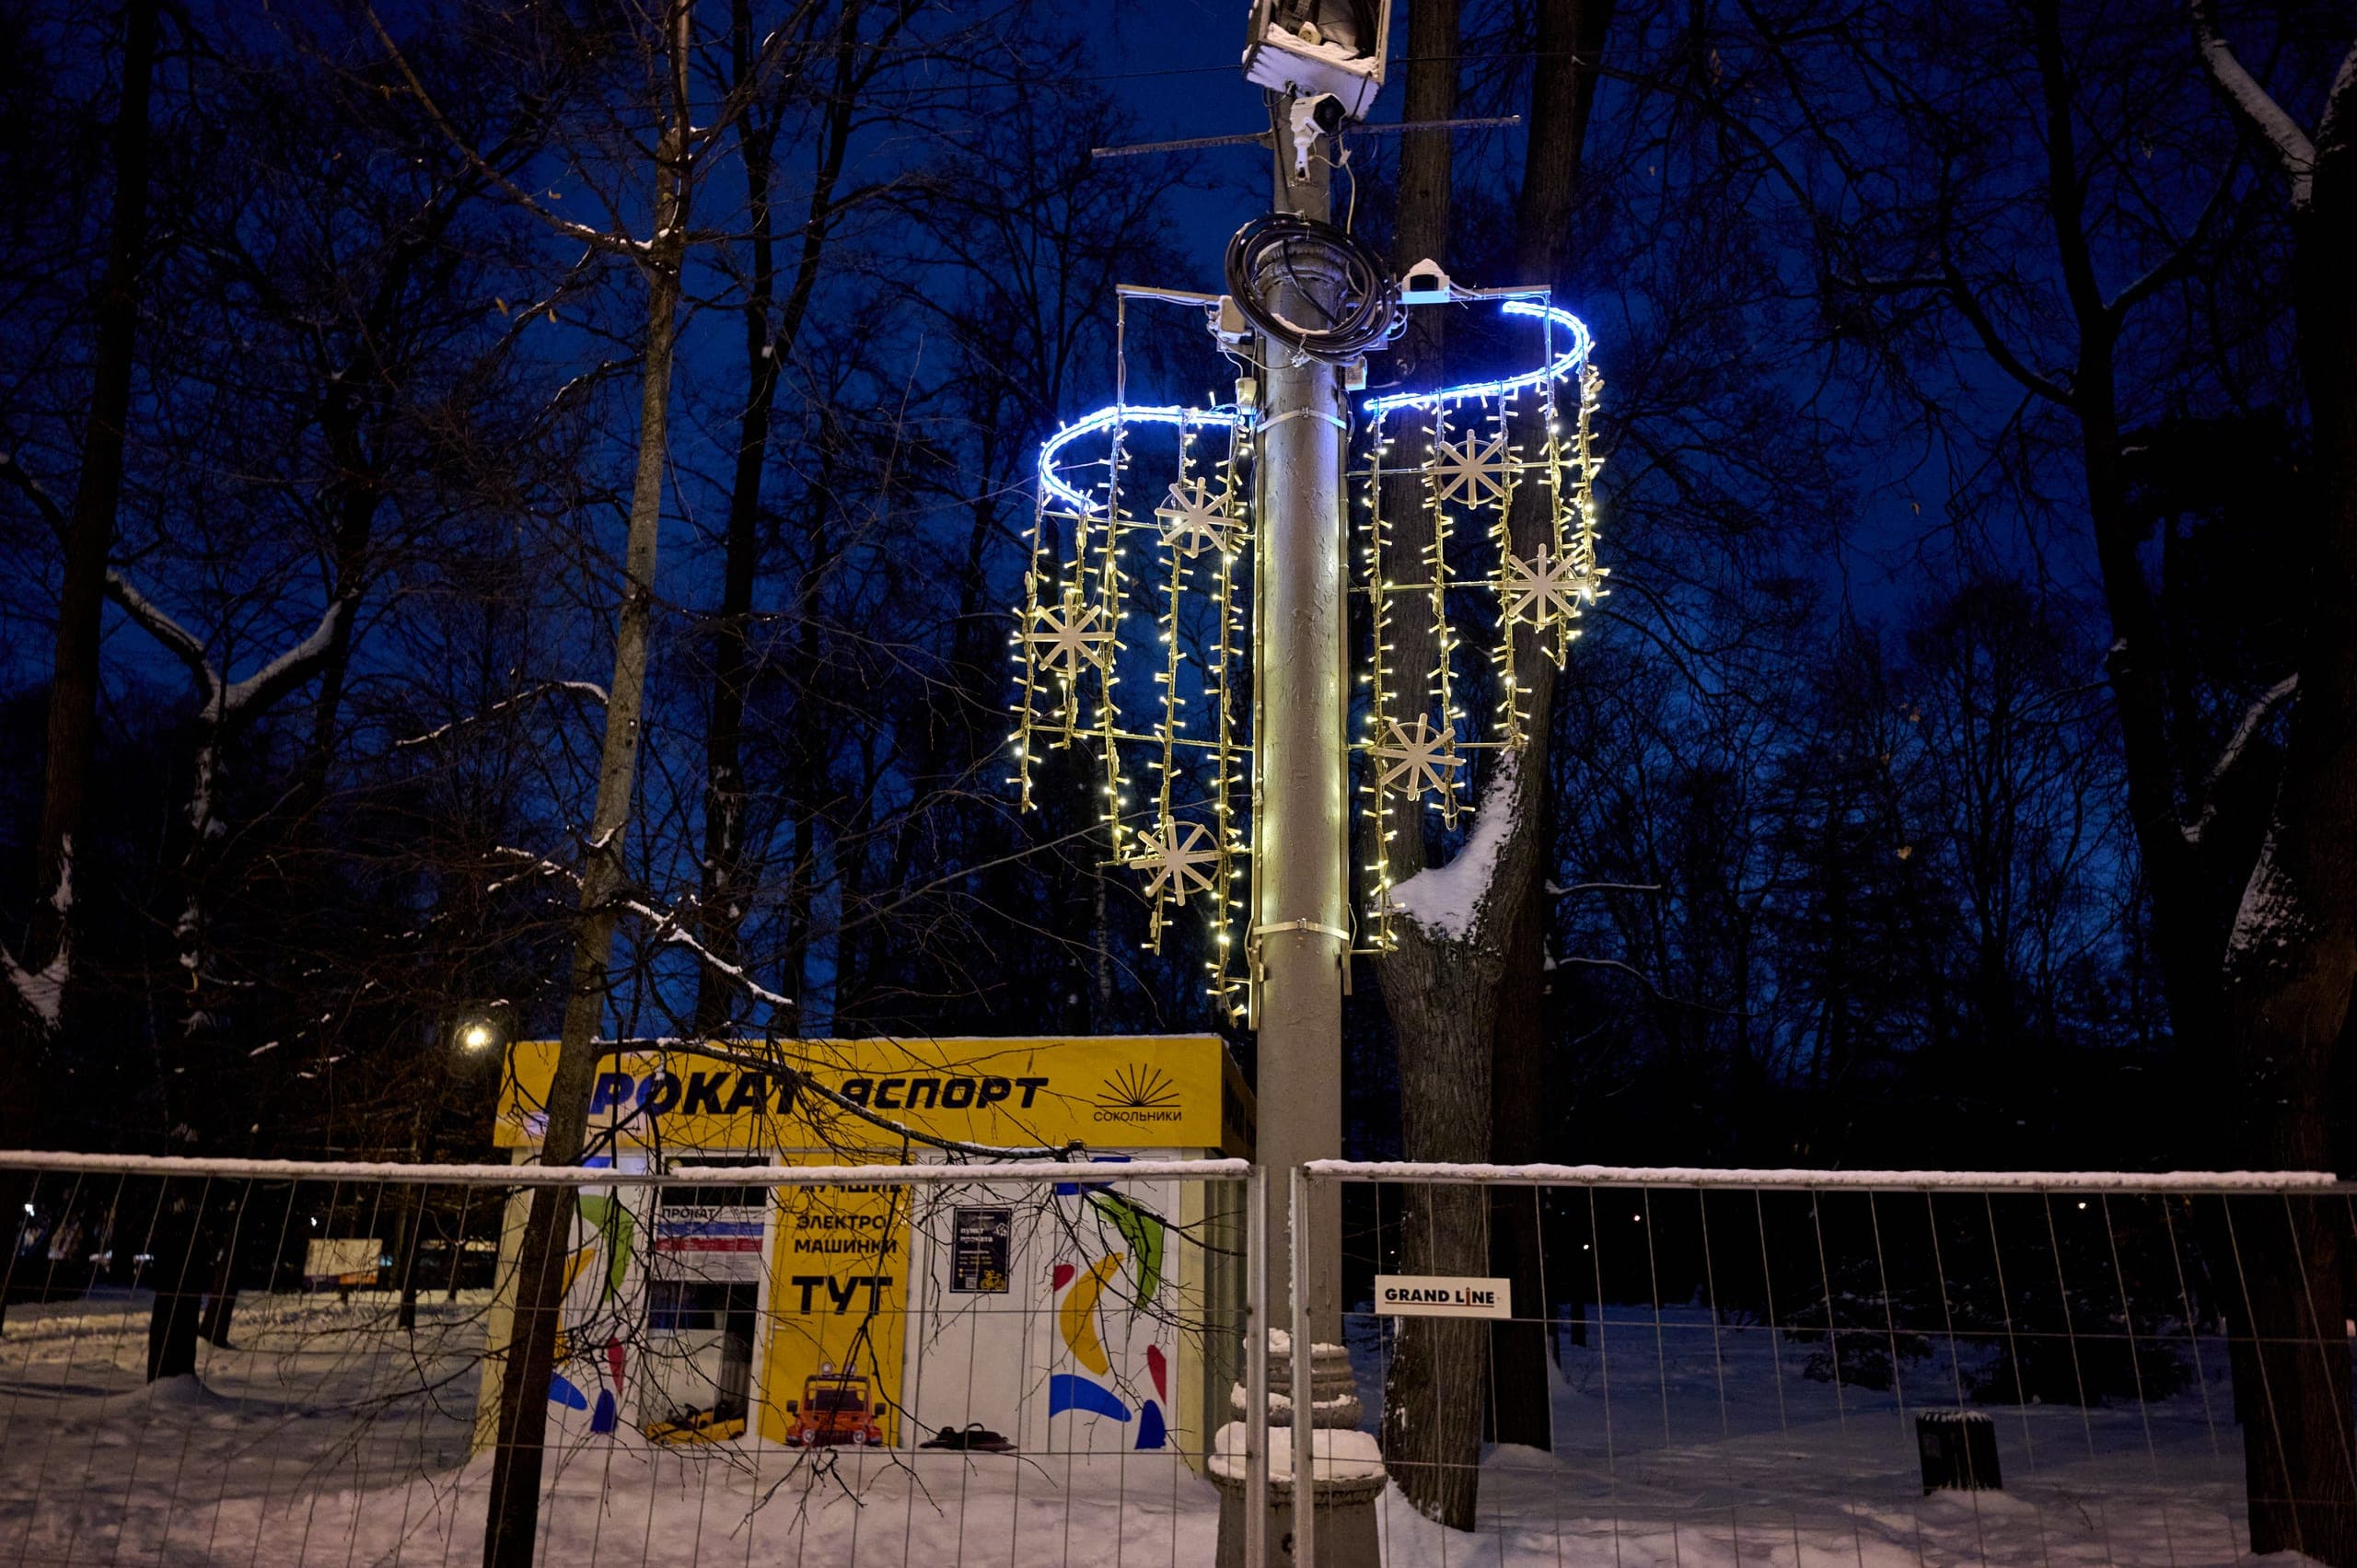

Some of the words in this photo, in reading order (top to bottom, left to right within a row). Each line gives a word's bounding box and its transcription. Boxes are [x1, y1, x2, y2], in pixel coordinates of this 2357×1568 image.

[545, 1072, 814, 1115] РОКАТ
[1093, 1111, 1182, 1121] СОКОЛЬНИКИ
[662, 1207, 716, 1218] ПРОКАТ
[795, 1214, 887, 1229] ЭЛЕКТРО
[795, 1238, 898, 1253] МАШИНКИ
[792, 1275, 893, 1315] ТУТ
[1385, 1288, 1449, 1302] GRAND
